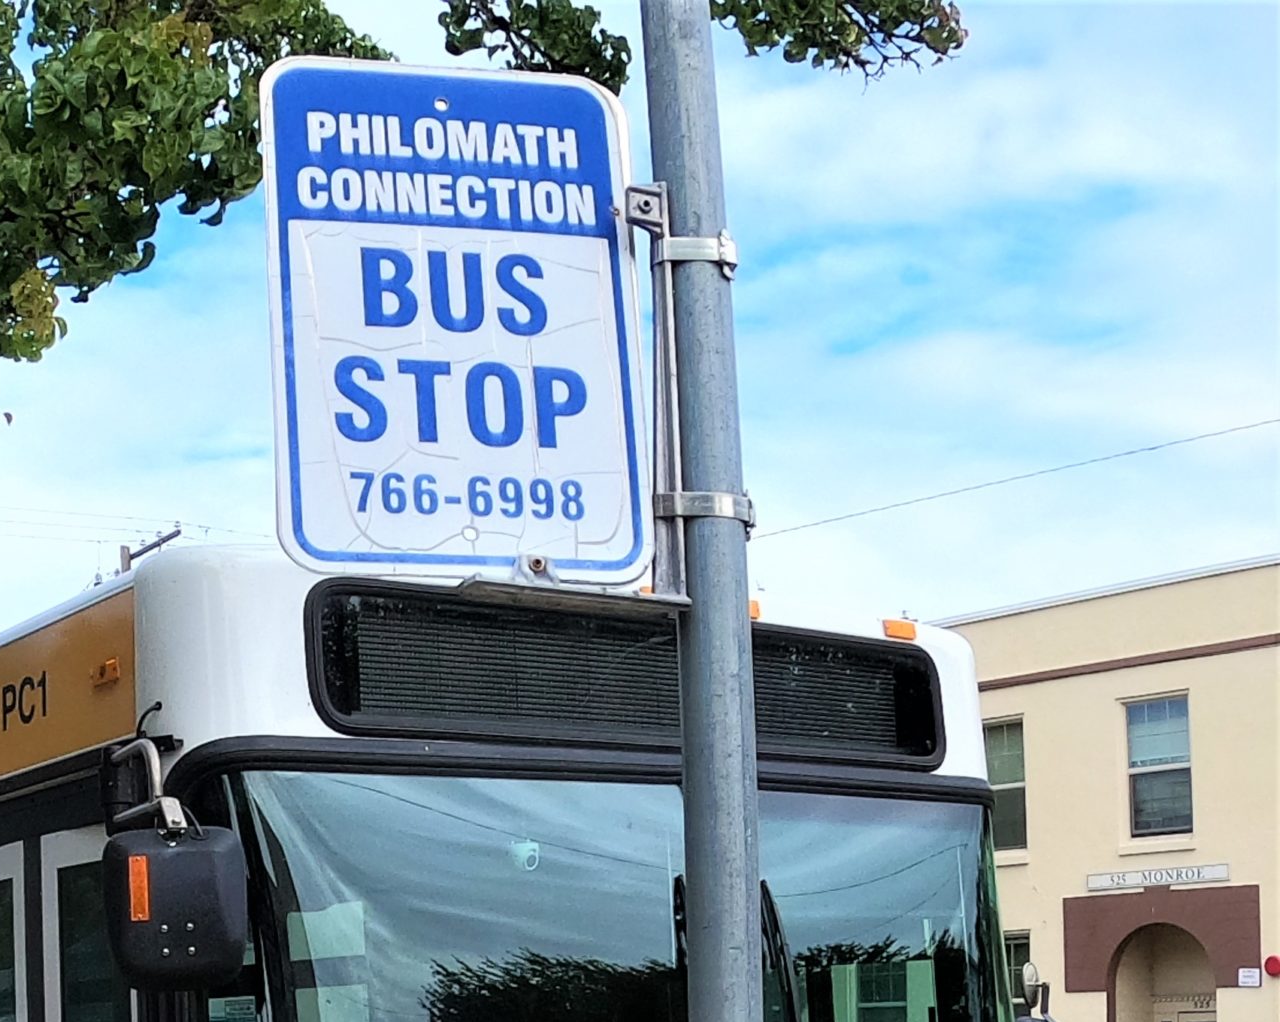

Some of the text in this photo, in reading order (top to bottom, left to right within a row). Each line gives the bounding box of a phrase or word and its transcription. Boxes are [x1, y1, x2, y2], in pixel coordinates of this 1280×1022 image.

[306, 110, 580, 169] PHILOMATH
[296, 166, 597, 227] CONNECTION
[359, 246, 549, 337] BUS
[333, 355, 588, 449] STOP
[349, 471, 586, 522] 766-6998
[2, 671, 48, 731] PC1
[1141, 868, 1206, 884] MONROE
